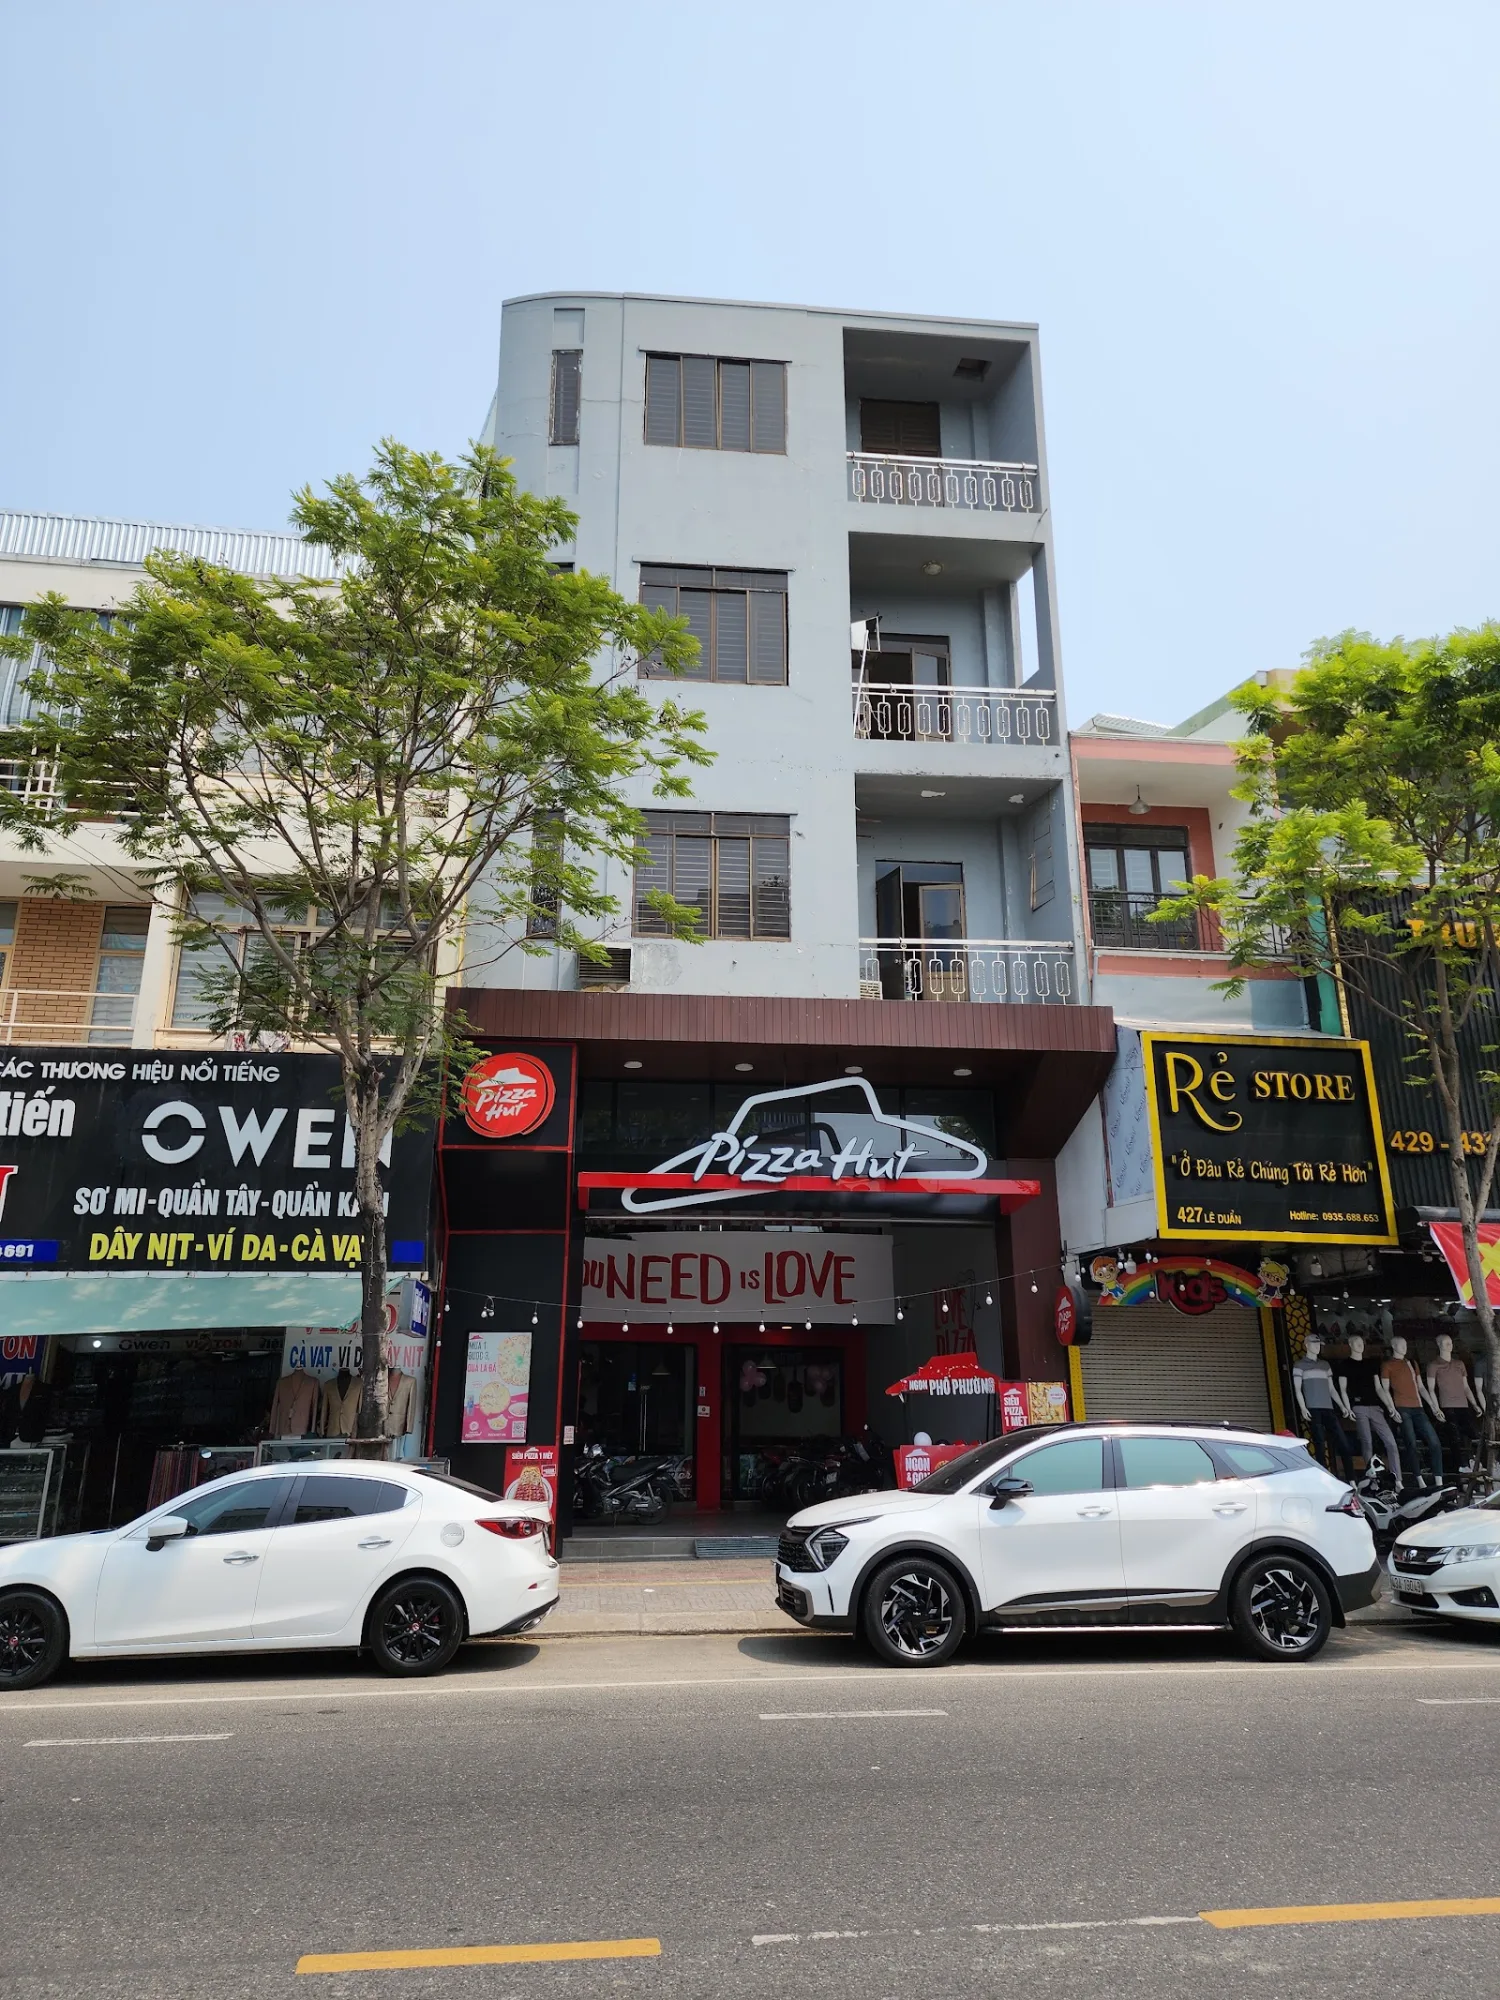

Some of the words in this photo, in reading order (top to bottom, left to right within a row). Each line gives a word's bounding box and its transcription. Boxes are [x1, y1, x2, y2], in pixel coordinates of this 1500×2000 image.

[40, 1061, 126, 1080] THƯƠNG
[132, 1059, 174, 1085] HIỆU
[181, 1056, 218, 1082] NỔI
[223, 1059, 281, 1083] TIẾNG
[475, 1086, 537, 1112] Pizza
[1165, 1051, 1242, 1132] Rẻ
[1254, 1070, 1357, 1102] STORE
[485, 1101, 528, 1122] Hut
[1390, 1130, 1434, 1153] 429
[692, 1131, 823, 1183] Pizza
[829, 1135, 930, 1181] Hut
[1196, 1158, 1222, 1178] Đâu
[1227, 1157, 1245, 1179] Rẻ
[1251, 1158, 1289, 1185] Chúng
[1293, 1161, 1314, 1182] Tôi
[1319, 1162, 1337, 1183] Rẻ
[73, 1185, 111, 1216] SƠ
[1177, 1206, 1203, 1223] 427
[1203, 1211, 1216, 1223] LÊ
[1289, 1210, 1319, 1222] Hotline:
[1322, 1212, 1379, 1223] 0935.688.653
[0, 1243, 34, 1258] 691
[89, 1227, 143, 1262] DÂY
[332, 1234, 365, 1269] VẠ
[606, 1252, 731, 1305] NEED
[764, 1250, 856, 1305] LOVE
[289, 1340, 306, 1368] CÀ
[338, 1340, 352, 1367] VÍ
[909, 1379, 928, 1391] NGON
[1004, 1406, 1024, 1415] PIZZA
[905, 1457, 931, 1471] NGON
